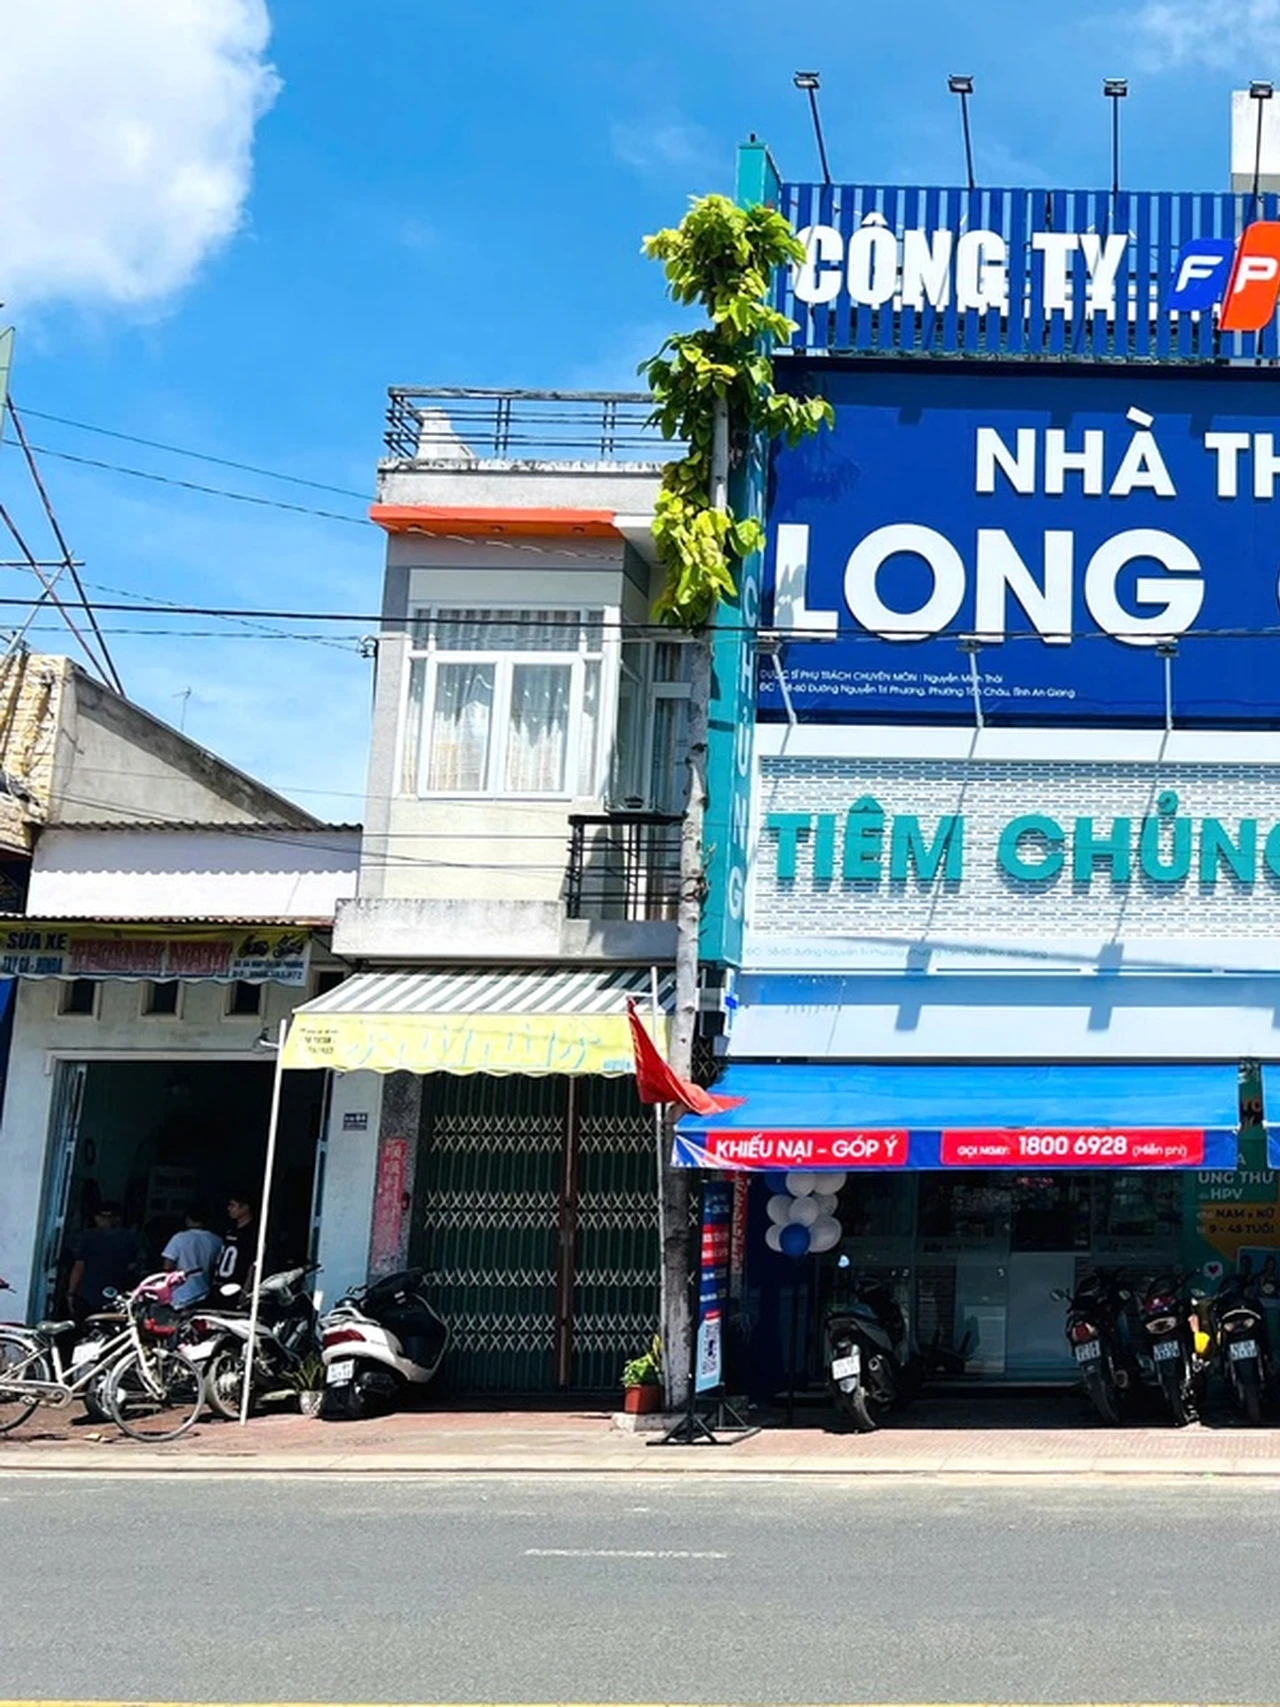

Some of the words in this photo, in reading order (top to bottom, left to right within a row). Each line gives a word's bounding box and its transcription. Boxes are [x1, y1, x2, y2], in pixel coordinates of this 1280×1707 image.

[794, 213, 1006, 308] CÔNG
[1033, 234, 1128, 314] TY
[976, 408, 1176, 496] NHÀ
[774, 523, 1205, 646] LONG
[767, 795, 964, 881] TIÊM
[45, 933, 68, 950] XE
[716, 1133, 772, 1158] KHIẾU
[777, 1140, 813, 1163] NẠI
[832, 1135, 879, 1157] GÓP
[884, 1134, 898, 1157] Ý
[1019, 1136, 1067, 1155] 1800
[1074, 1136, 1127, 1155] 6928
[1210, 1188, 1243, 1200] HPV
[1215, 1207, 1245, 1218] NAM
